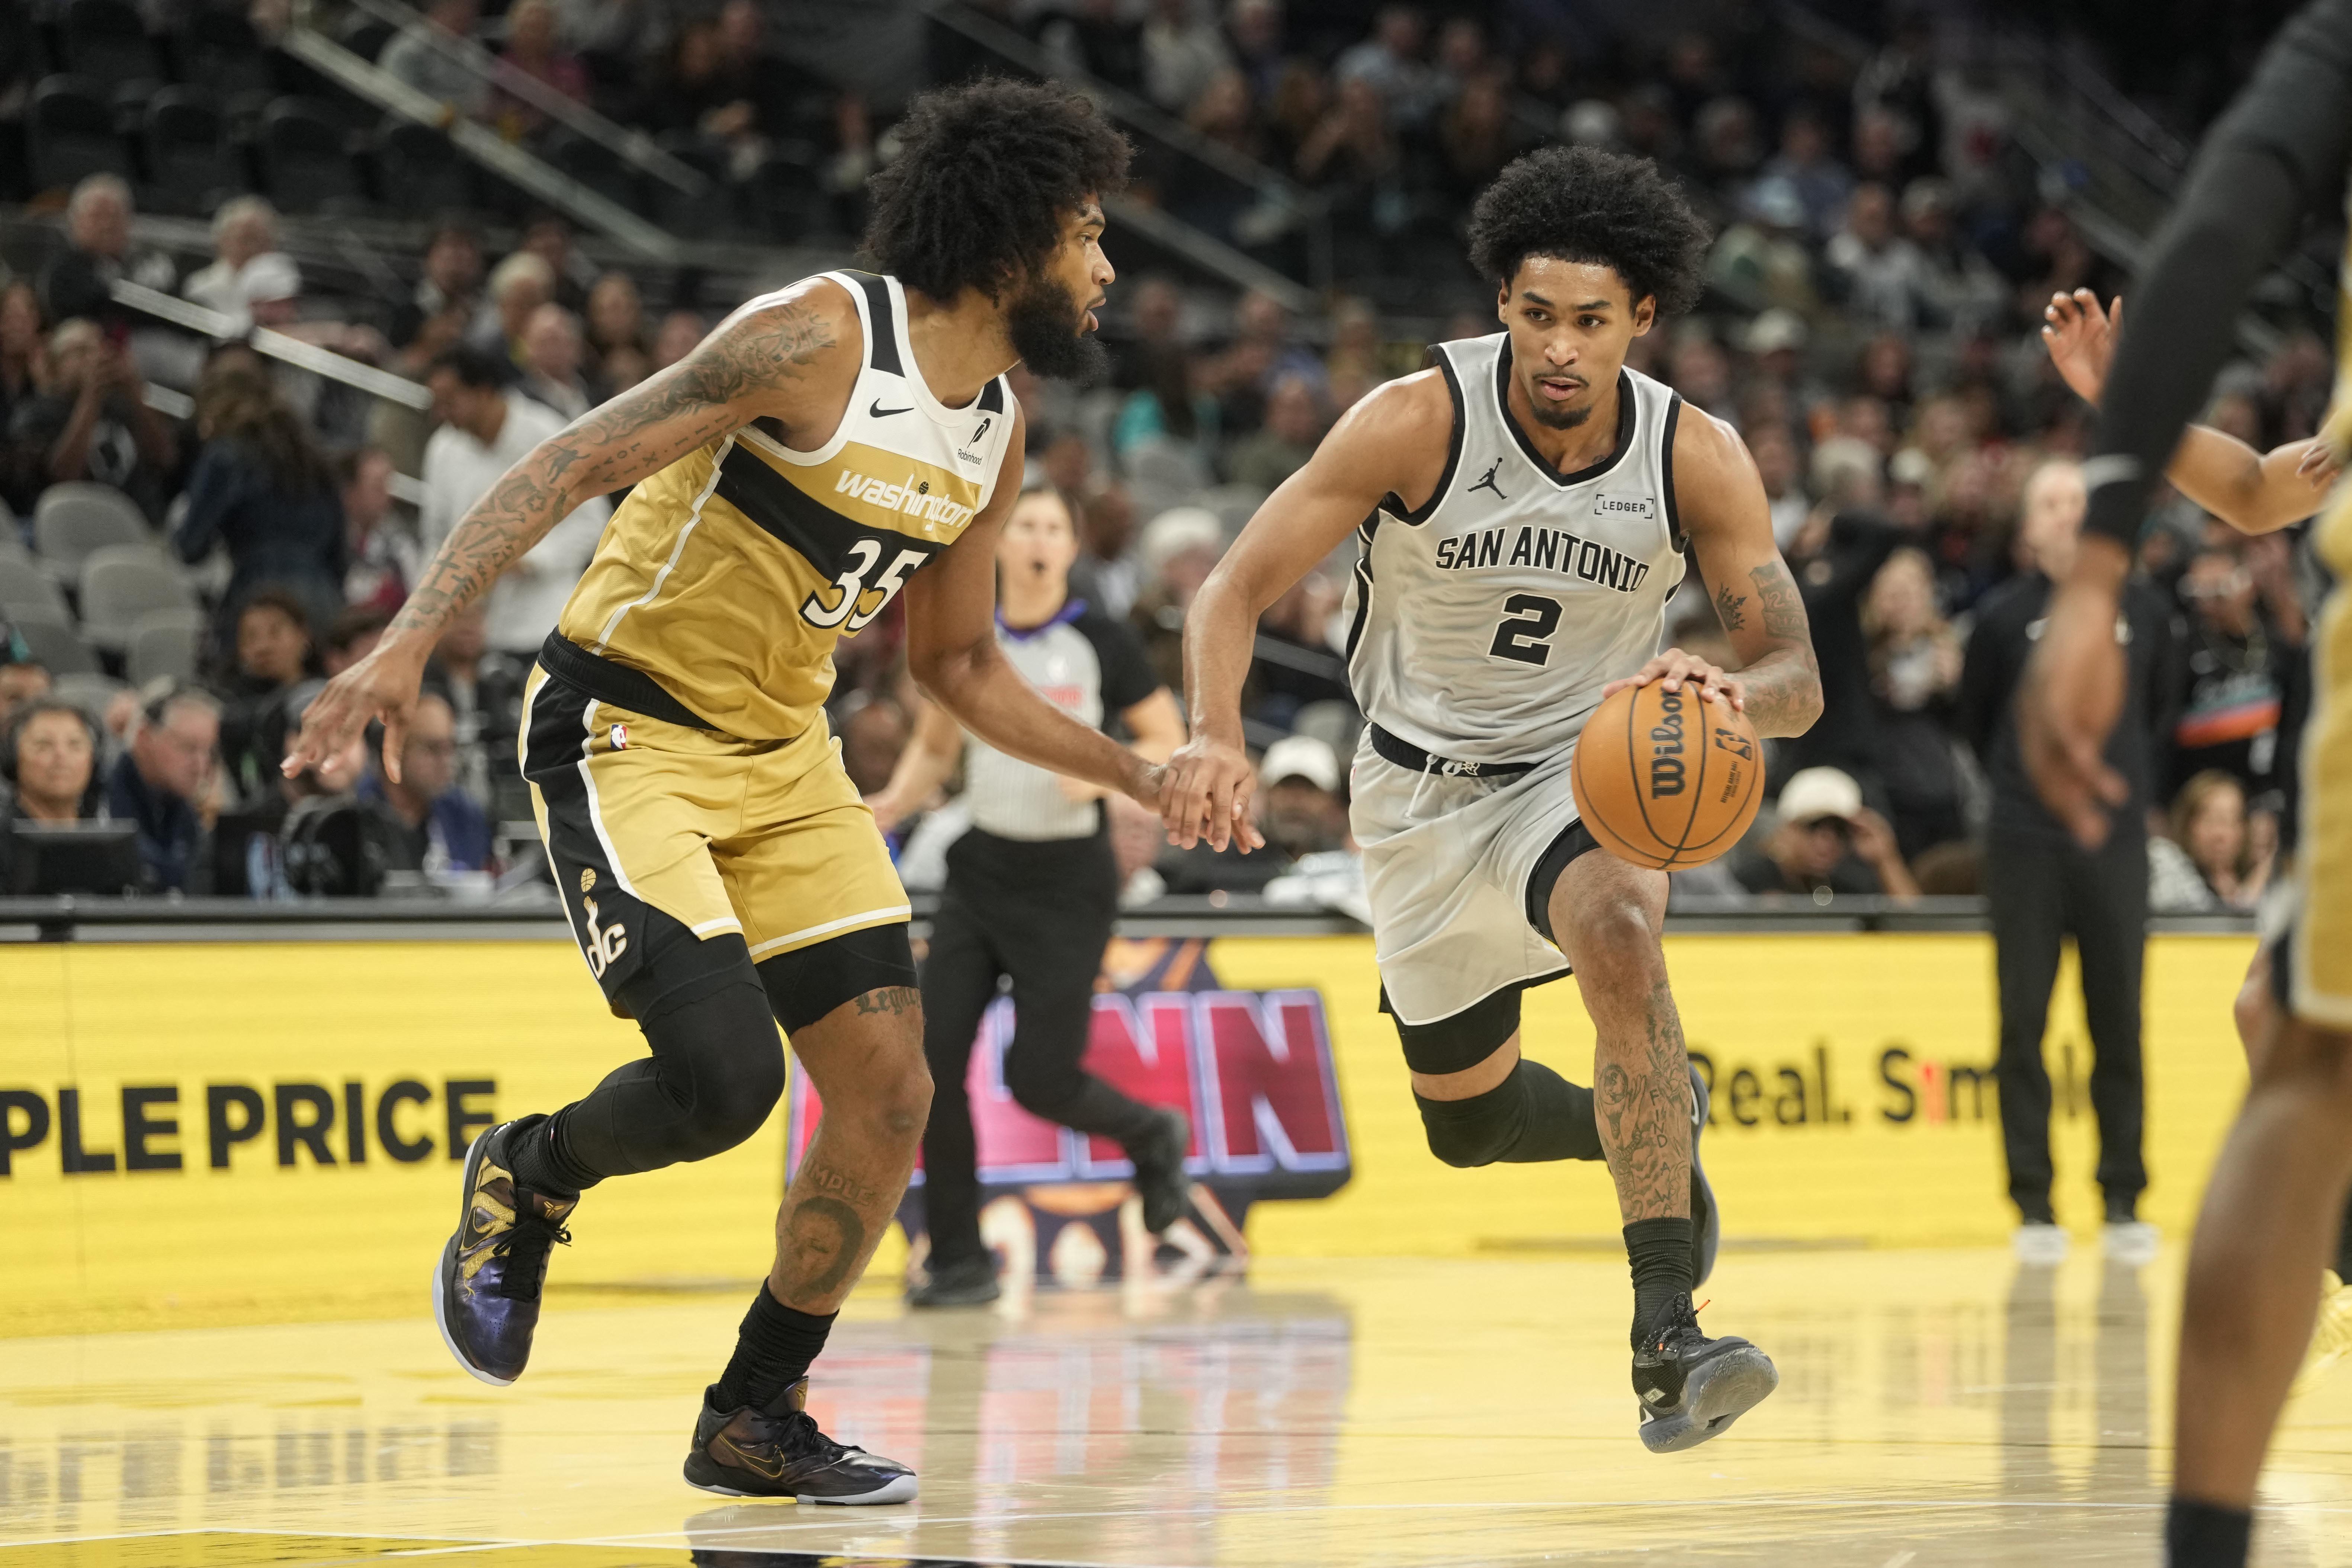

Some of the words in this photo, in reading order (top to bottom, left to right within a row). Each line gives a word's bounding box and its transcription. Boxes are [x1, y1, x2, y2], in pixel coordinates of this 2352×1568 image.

[957, 449, 983, 465] Robinhood
[835, 473, 974, 531] washington
[1602, 501, 1645, 512] LEDGER
[800, 538, 929, 631] 35
[1436, 526, 1507, 571] SAN
[1508, 525, 1650, 593] ANTONIO
[1487, 592, 1565, 668] 2
[1650, 686, 1686, 799] Wilson
[1880, 1045, 2079, 1123] Siml
[0, 1086, 184, 1177] PLE
[206, 1080, 497, 1169] PRICE
[1655, 1188, 1673, 1219] WA
